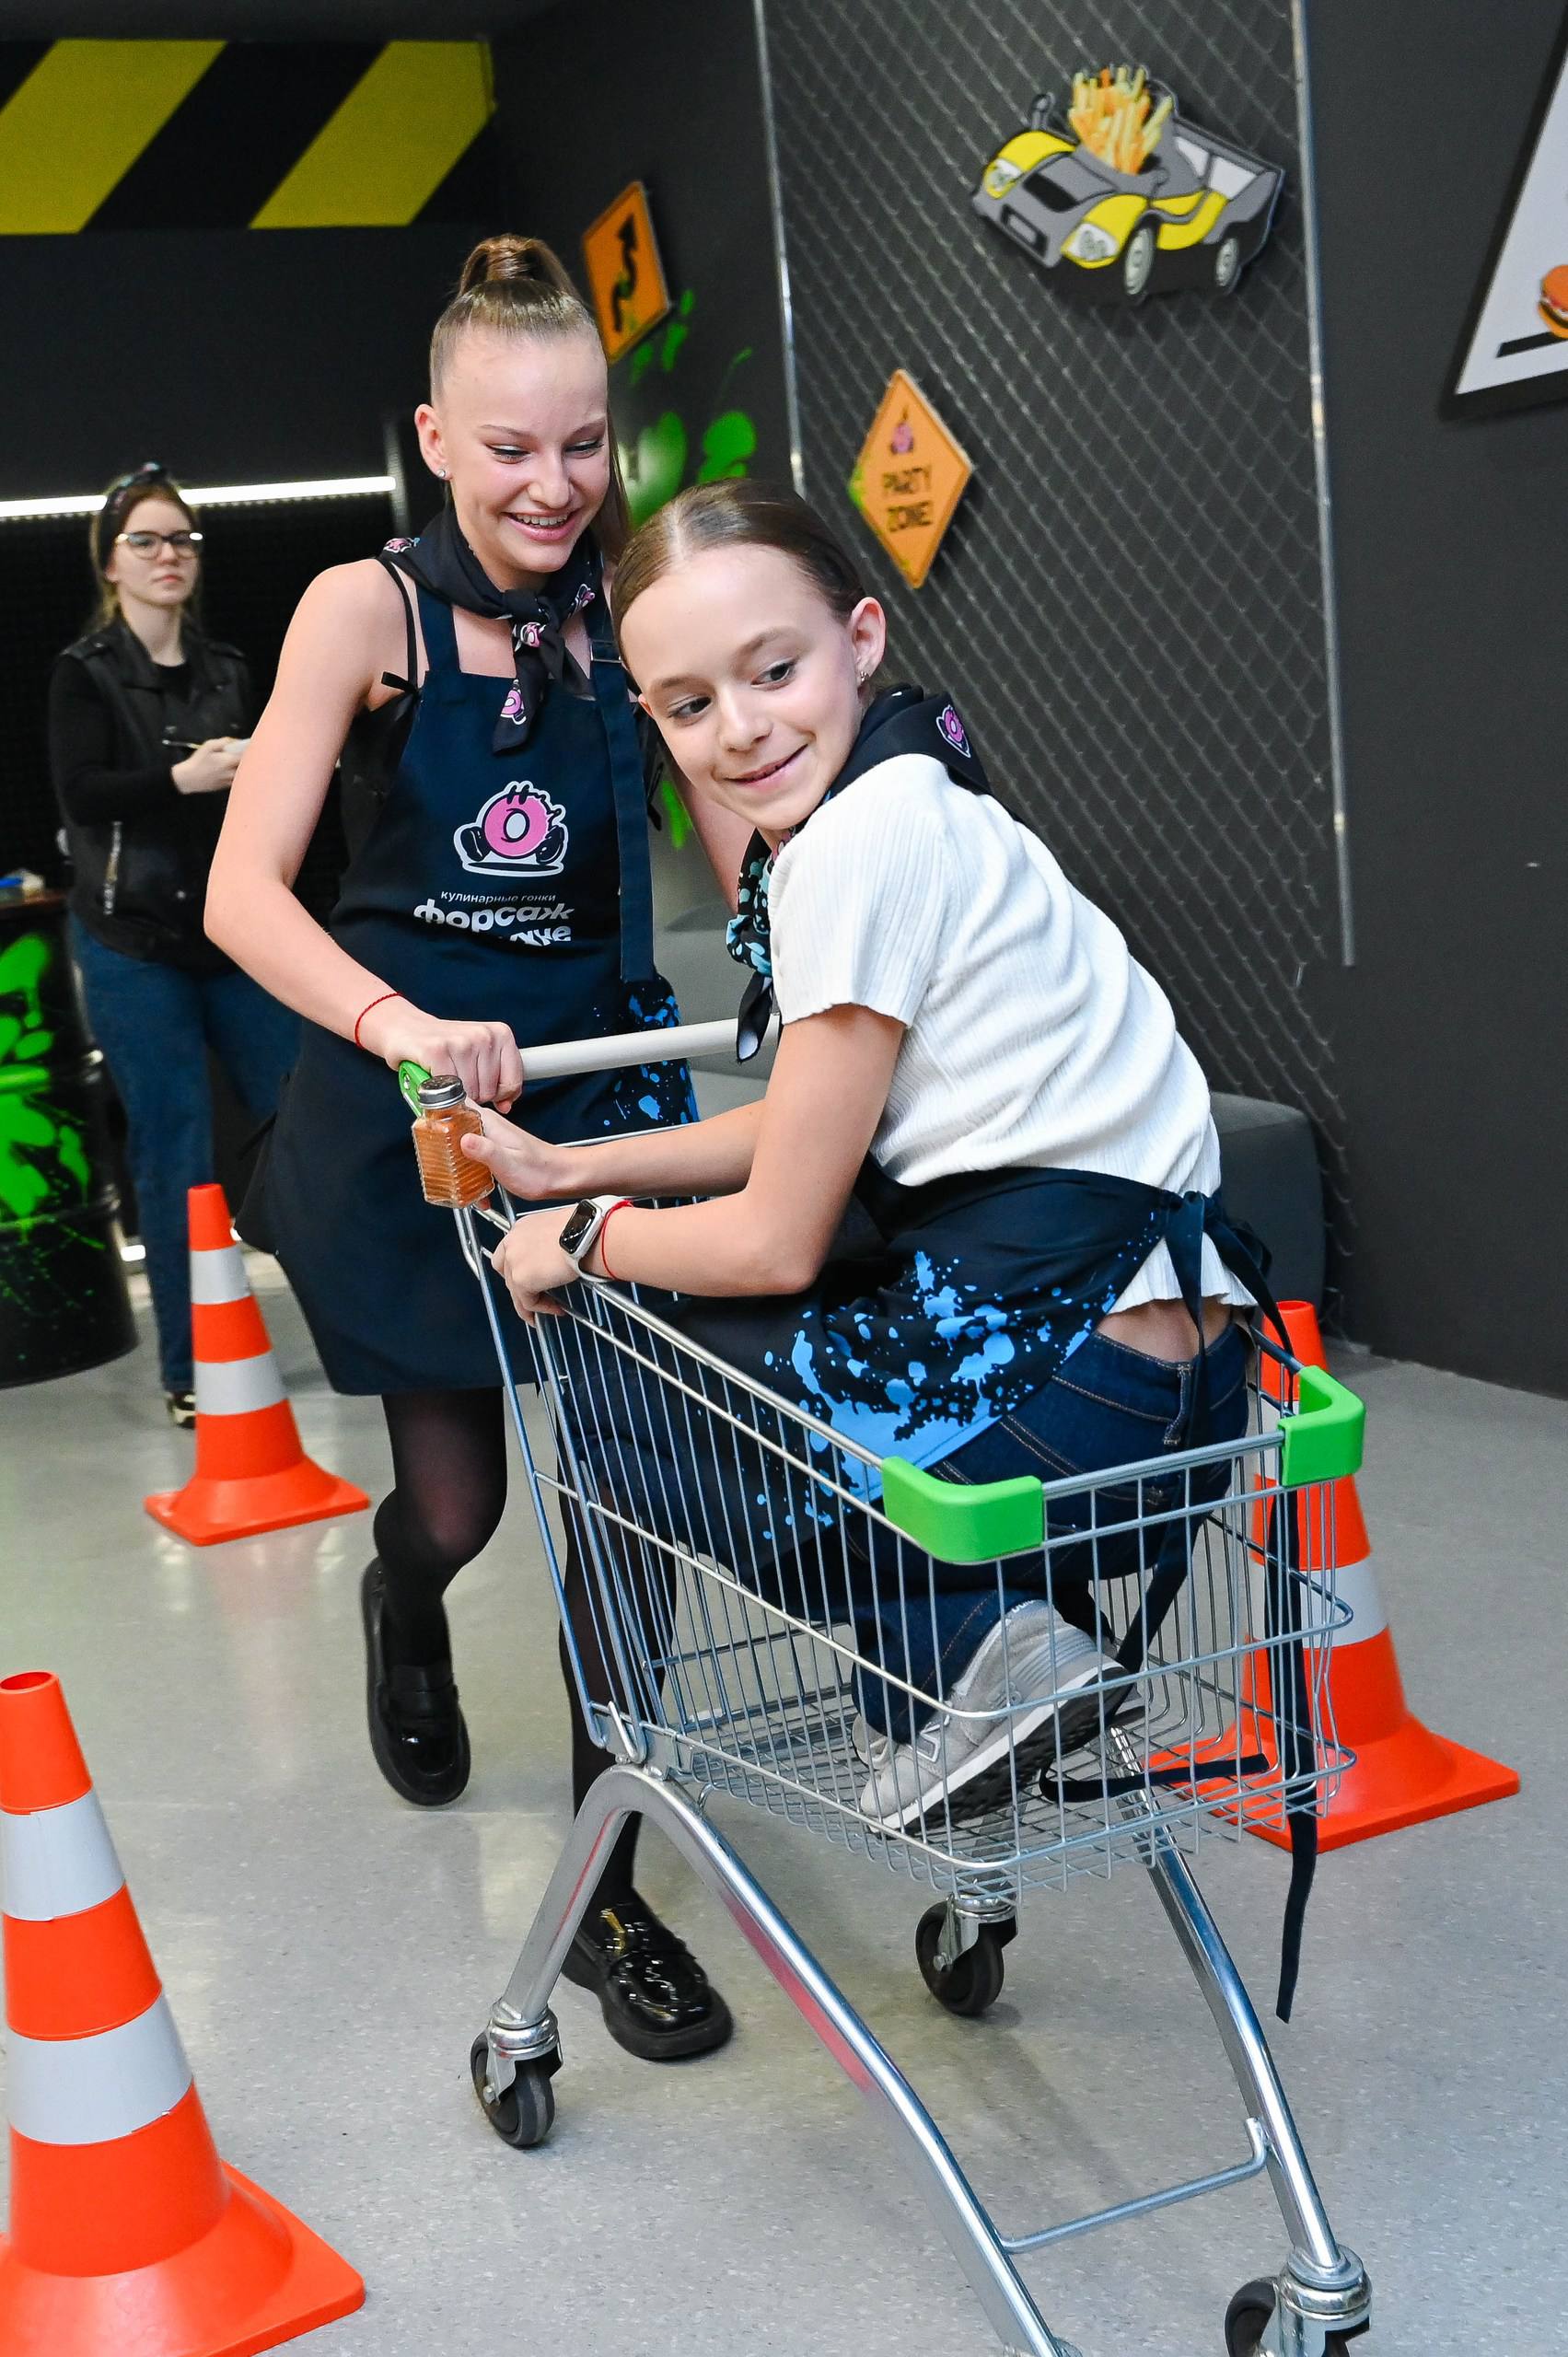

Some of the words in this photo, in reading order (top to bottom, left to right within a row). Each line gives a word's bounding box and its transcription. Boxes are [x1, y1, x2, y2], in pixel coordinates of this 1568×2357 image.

[882, 465, 932, 496] PARTY
[887, 500, 932, 532] ZONE
[521, 894, 557, 902] гонки
